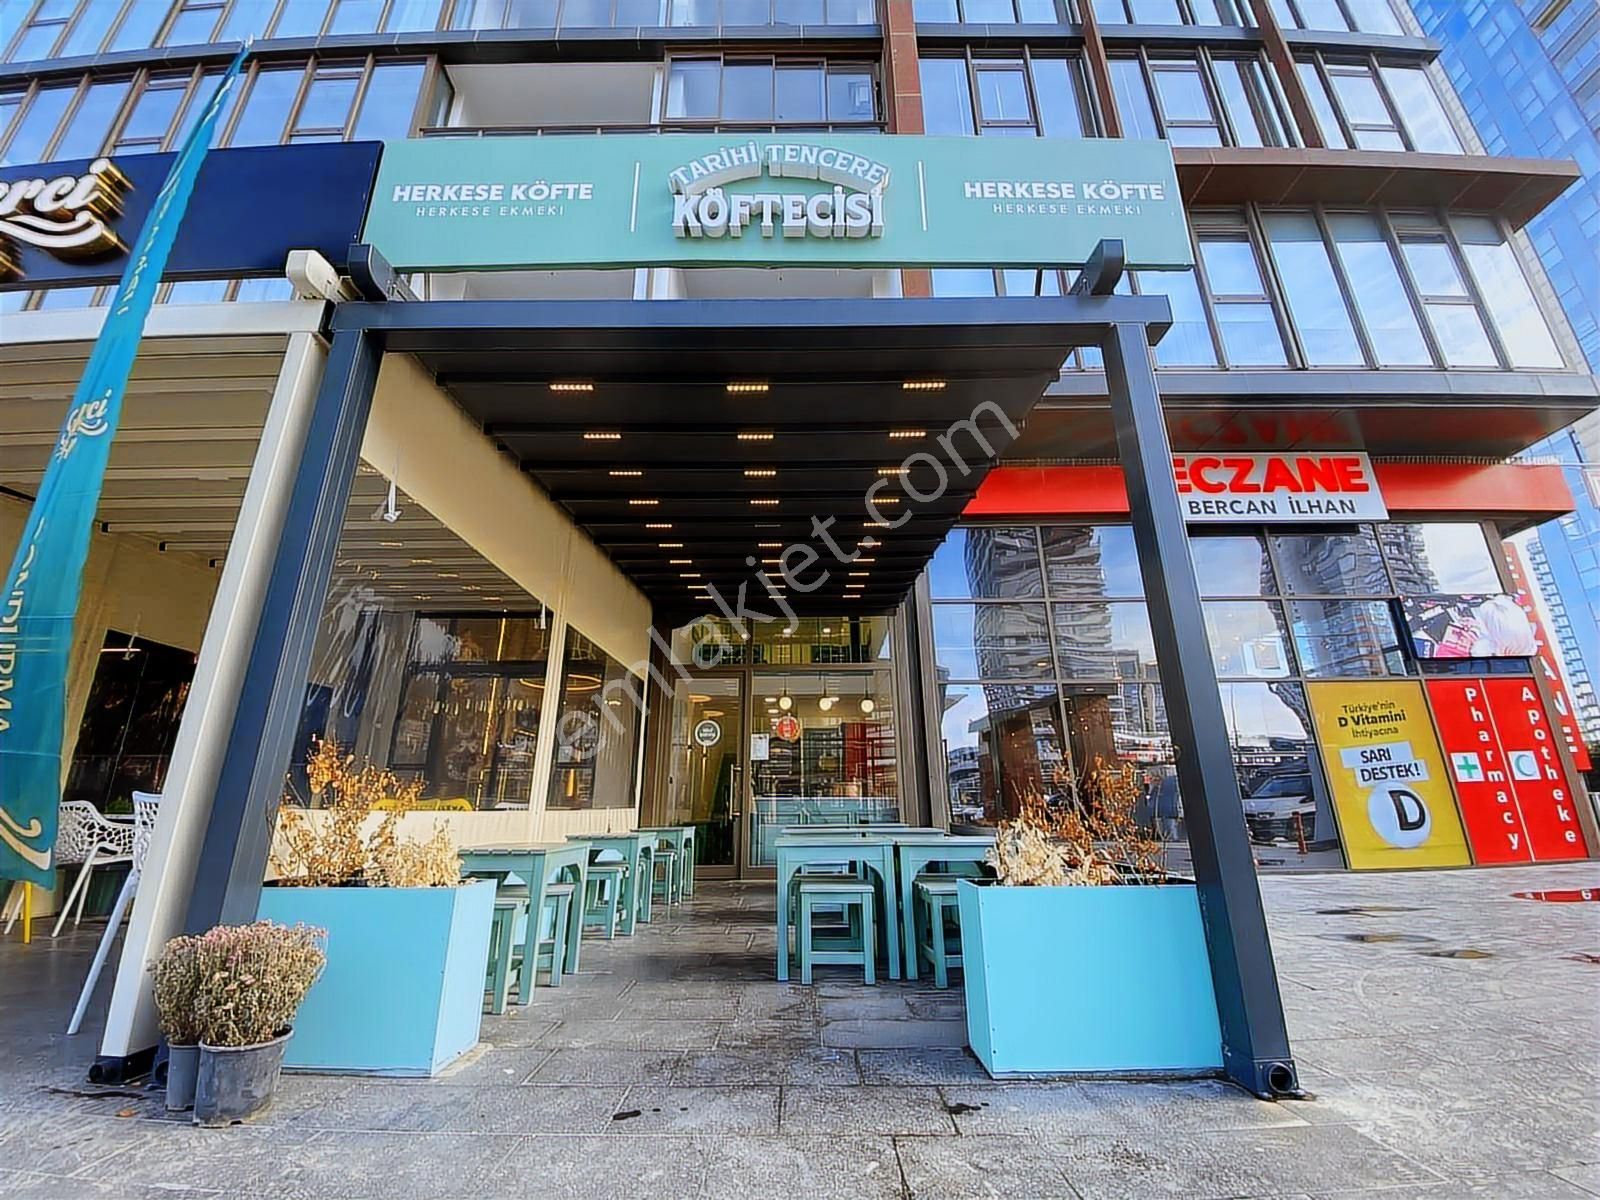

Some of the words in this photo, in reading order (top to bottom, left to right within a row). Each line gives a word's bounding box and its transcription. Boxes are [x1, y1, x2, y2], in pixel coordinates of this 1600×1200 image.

[669, 141, 760, 186] TARİHİ
[765, 144, 888, 184] TENCERE
[392, 184, 505, 202] HERKESE
[511, 180, 594, 201] KÖFTE
[963, 181, 1076, 199] HERKESE
[1083, 180, 1165, 200] KÖFTE
[415, 206, 491, 217] HERKESE
[671, 186, 884, 238] KÖFTECİSİ
[993, 203, 1069, 215] HERKESE
[1172, 455, 1370, 494] ECZANE
[1189, 500, 1276, 515] BERCAN
[1288, 496, 1356, 514] İLHAN
[1342, 700, 1396, 714] Türkiye'nin
[1337, 716, 1349, 728] D
[1350, 709, 1407, 726] Vitamini
[1360, 747, 1392, 764] SARI
[1522, 686, 1577, 843] Apotheke
[1360, 763, 1421, 782] DESTEK!
[1464, 687, 1518, 851] Pharmacy
[1387, 789, 1426, 831] D
